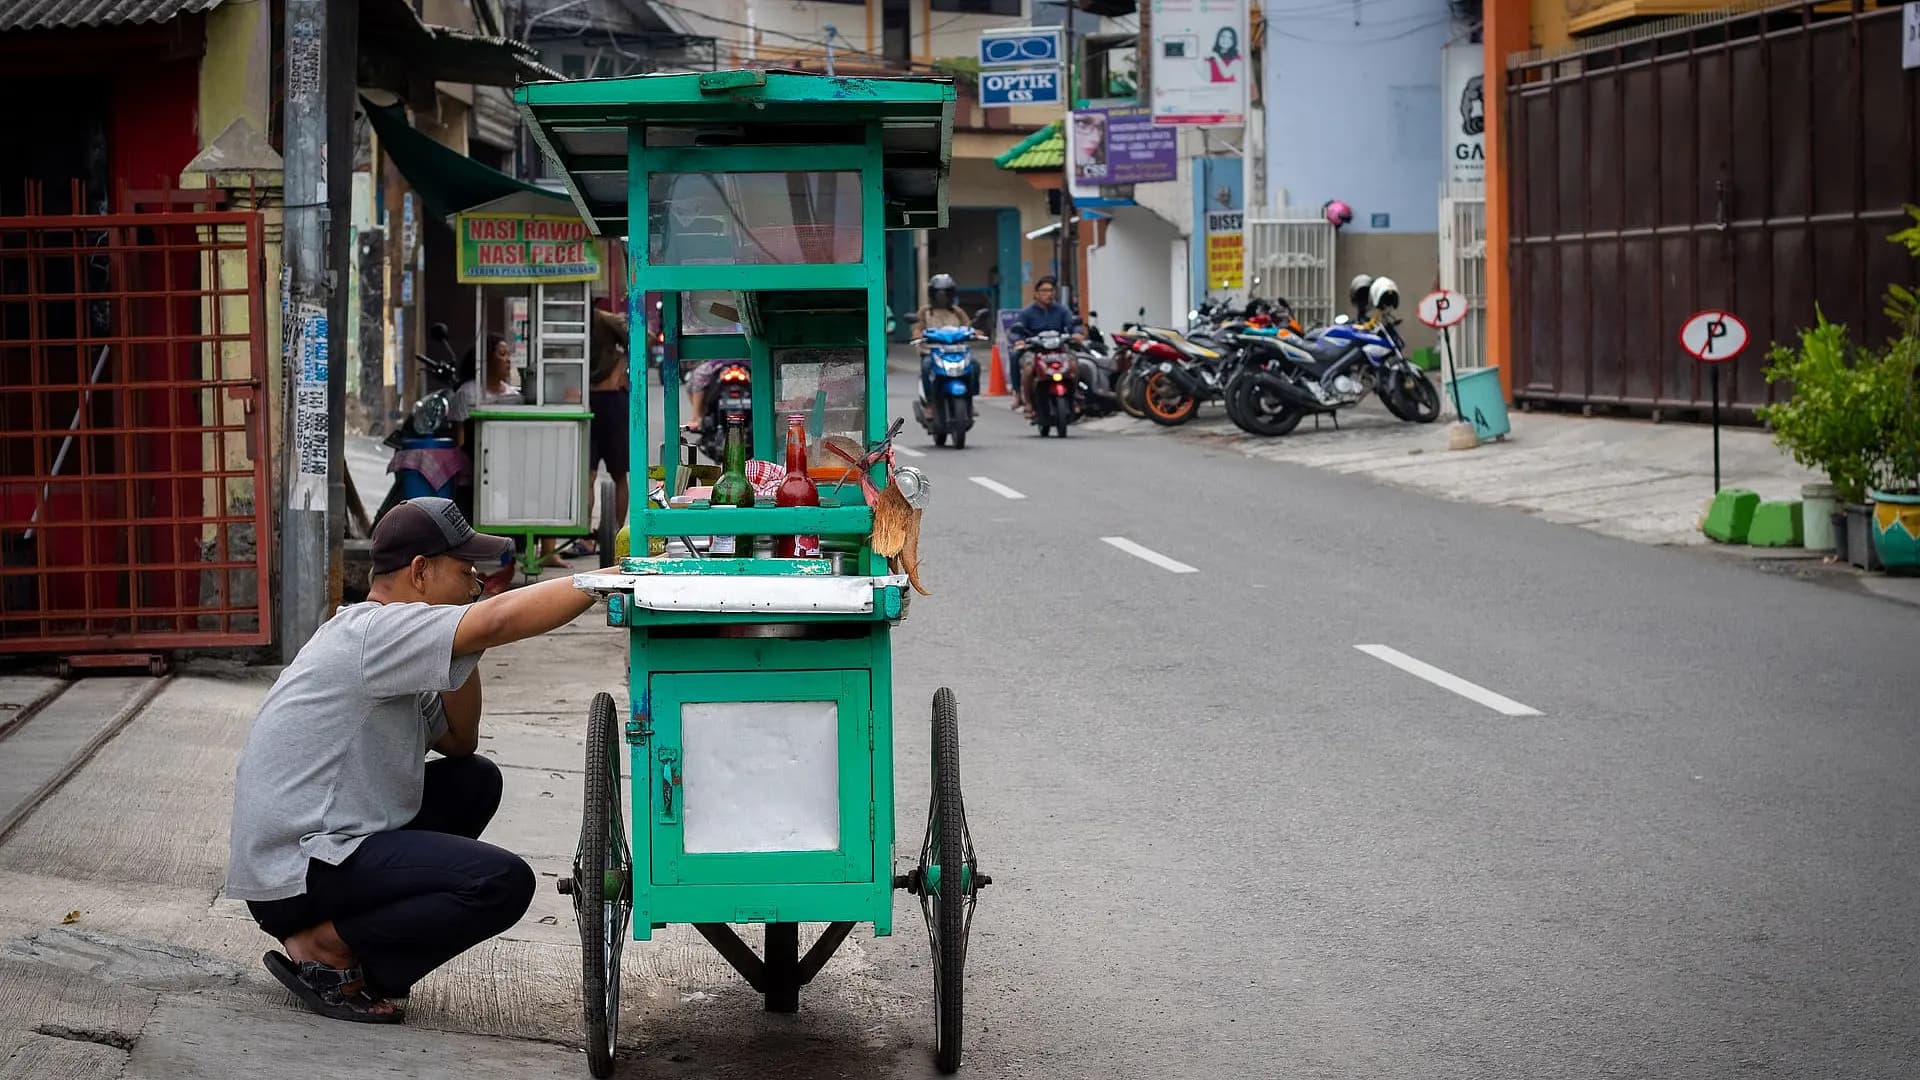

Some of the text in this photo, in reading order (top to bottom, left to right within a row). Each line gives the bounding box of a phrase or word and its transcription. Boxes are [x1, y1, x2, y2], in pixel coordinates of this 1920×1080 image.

[986, 75, 1053, 90] OPTIK
[1007, 89, 1033, 102] CSS
[469, 219, 517, 240] NASI
[479, 243, 586, 264] NASI PECEL
[1435, 297, 1450, 322] P
[1707, 321, 1727, 354] P
[299, 391, 307, 406] WC
[301, 434, 310, 474] SEDOT
